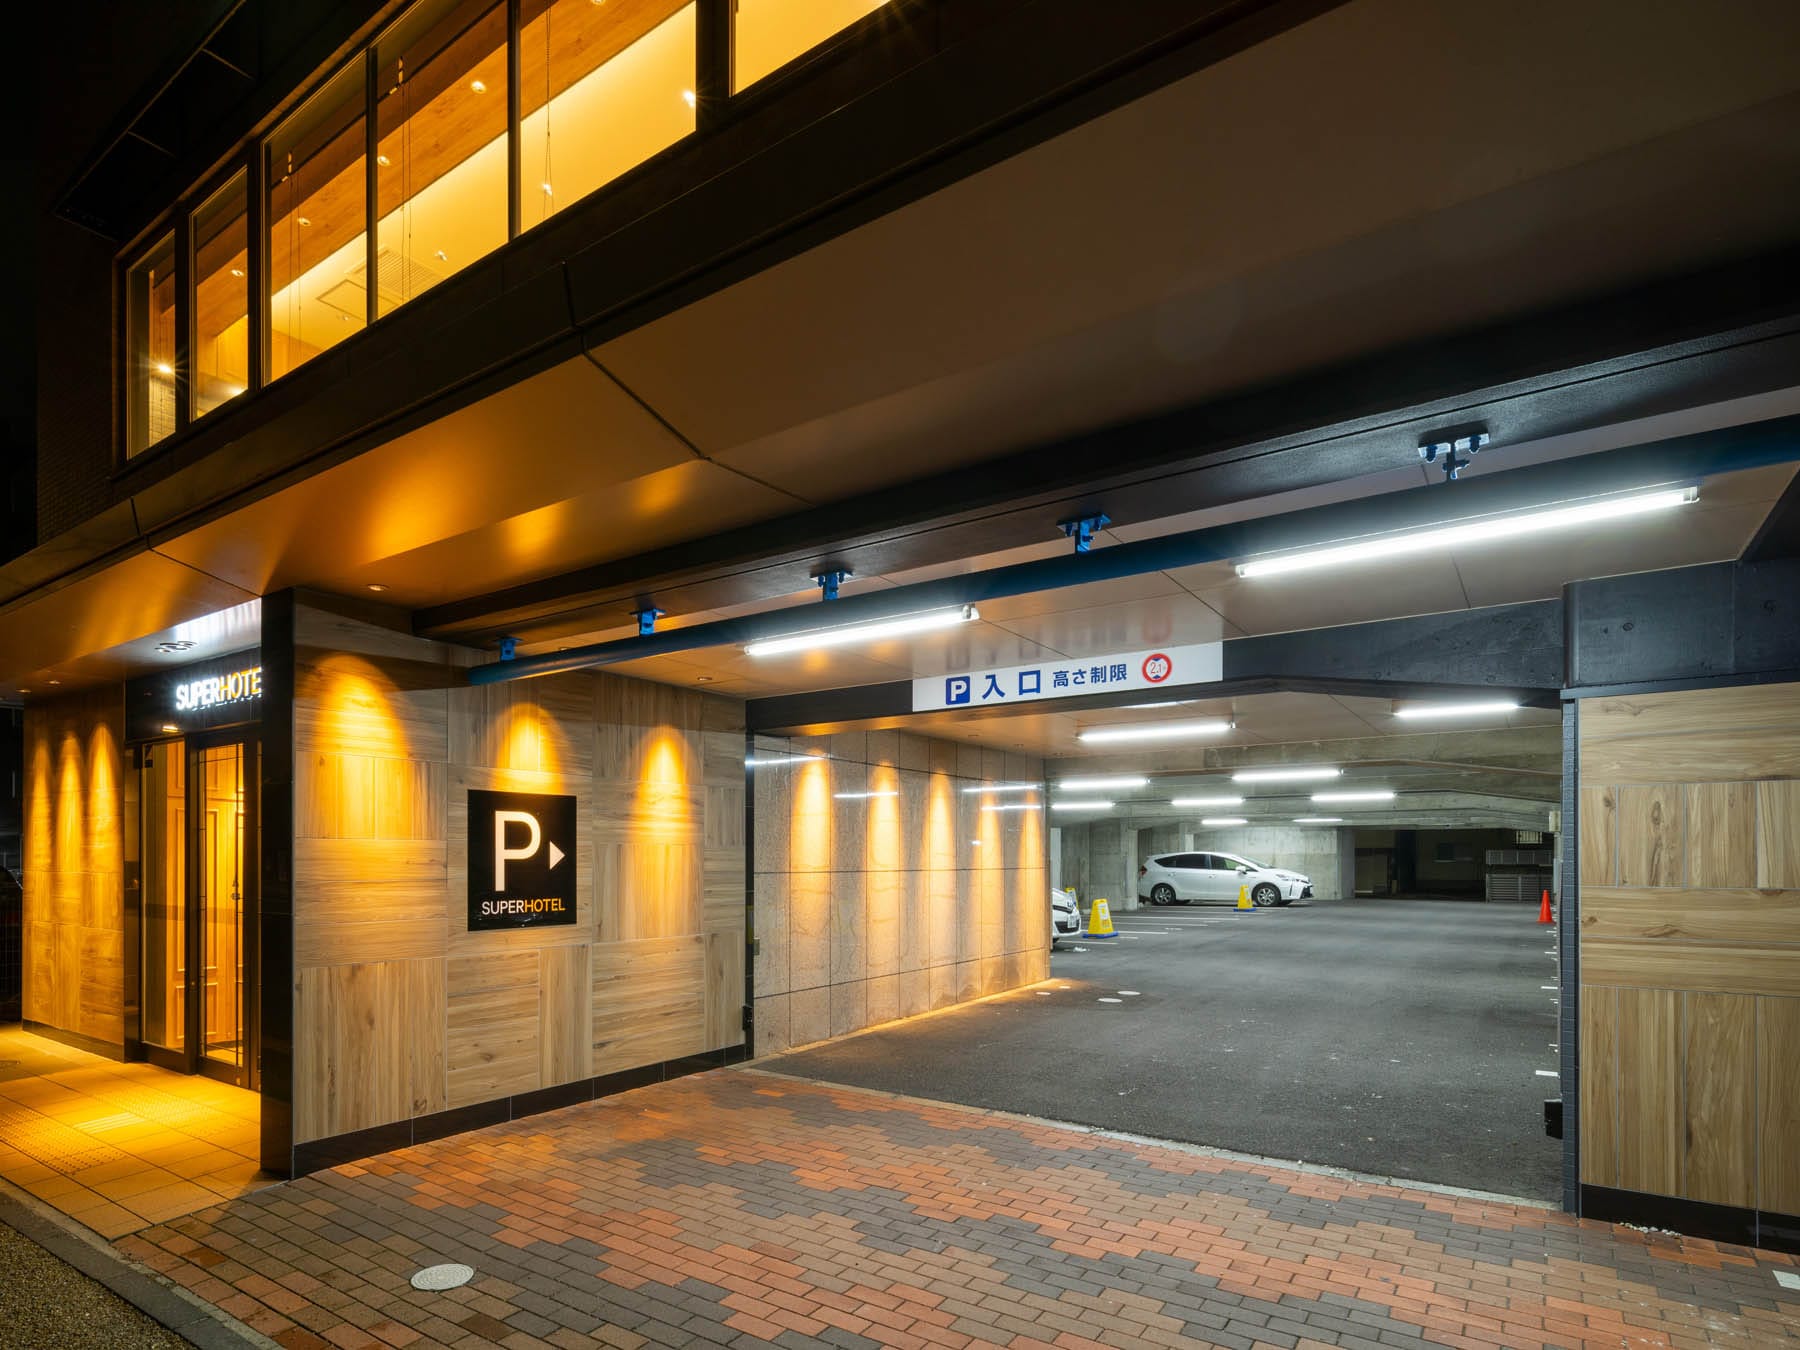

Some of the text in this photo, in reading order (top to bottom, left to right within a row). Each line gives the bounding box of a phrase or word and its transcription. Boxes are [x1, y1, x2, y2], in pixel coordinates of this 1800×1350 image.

[950, 680, 967, 702] P
[1053, 663, 1127, 688] 高さ制限
[495, 810, 541, 892] P
[481, 898, 566, 915] SUPERHOTEL
